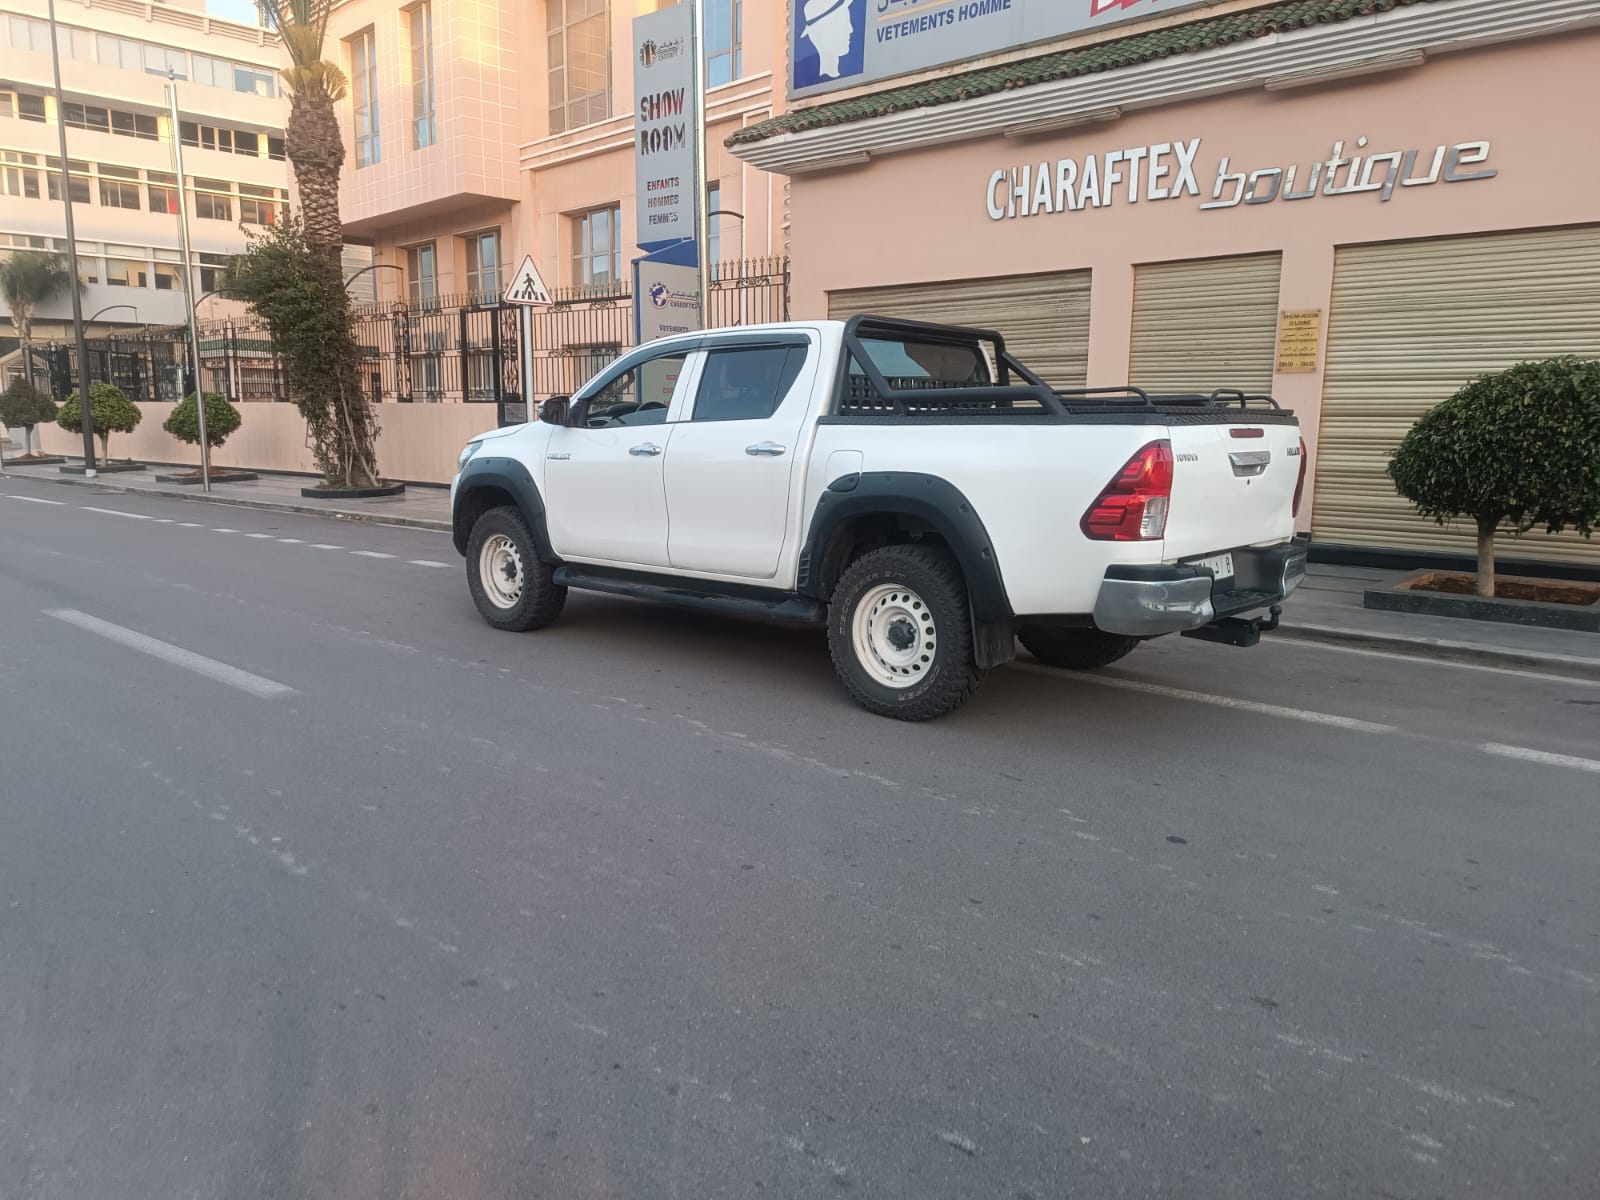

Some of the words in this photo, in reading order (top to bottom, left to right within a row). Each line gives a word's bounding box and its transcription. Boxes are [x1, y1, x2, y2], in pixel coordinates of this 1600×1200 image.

[876, 10, 954, 43] VETEMENTS
[958, 0, 1011, 22] HOMME
[641, 88, 685, 122] SHOW
[641, 122, 686, 156] ROOM
[647, 177, 680, 191] ENFANTS
[986, 138, 1202, 220] CHARAFTEX
[1200, 135, 1498, 211] boutique
[647, 194, 680, 208] HOMMES
[648, 212, 679, 225] FEMMES
